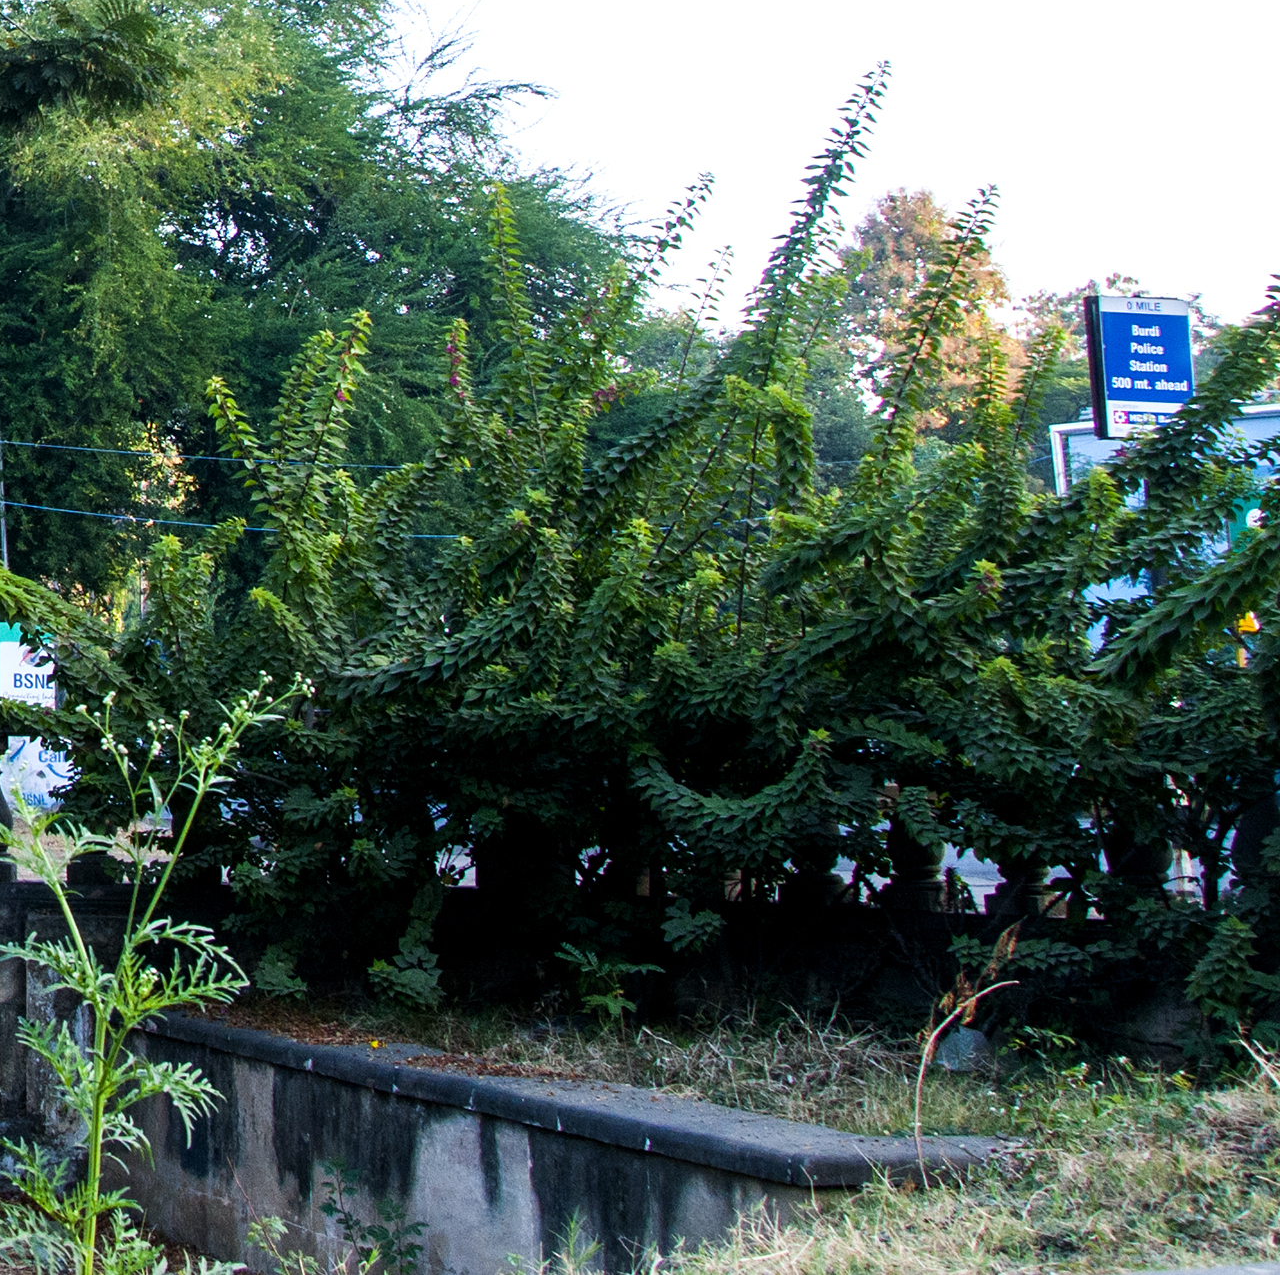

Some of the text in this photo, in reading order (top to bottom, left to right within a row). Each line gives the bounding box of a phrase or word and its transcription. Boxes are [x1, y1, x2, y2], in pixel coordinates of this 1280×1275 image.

[1135, 301, 1161, 312] MILE
[1131, 325, 1161, 337] Burdi
[1130, 342, 1165, 355] Police
[1129, 360, 1168, 373] Station
[1111, 377, 1189, 392] 500 mt. ahead
[13, 673, 54, 690] BSNL
